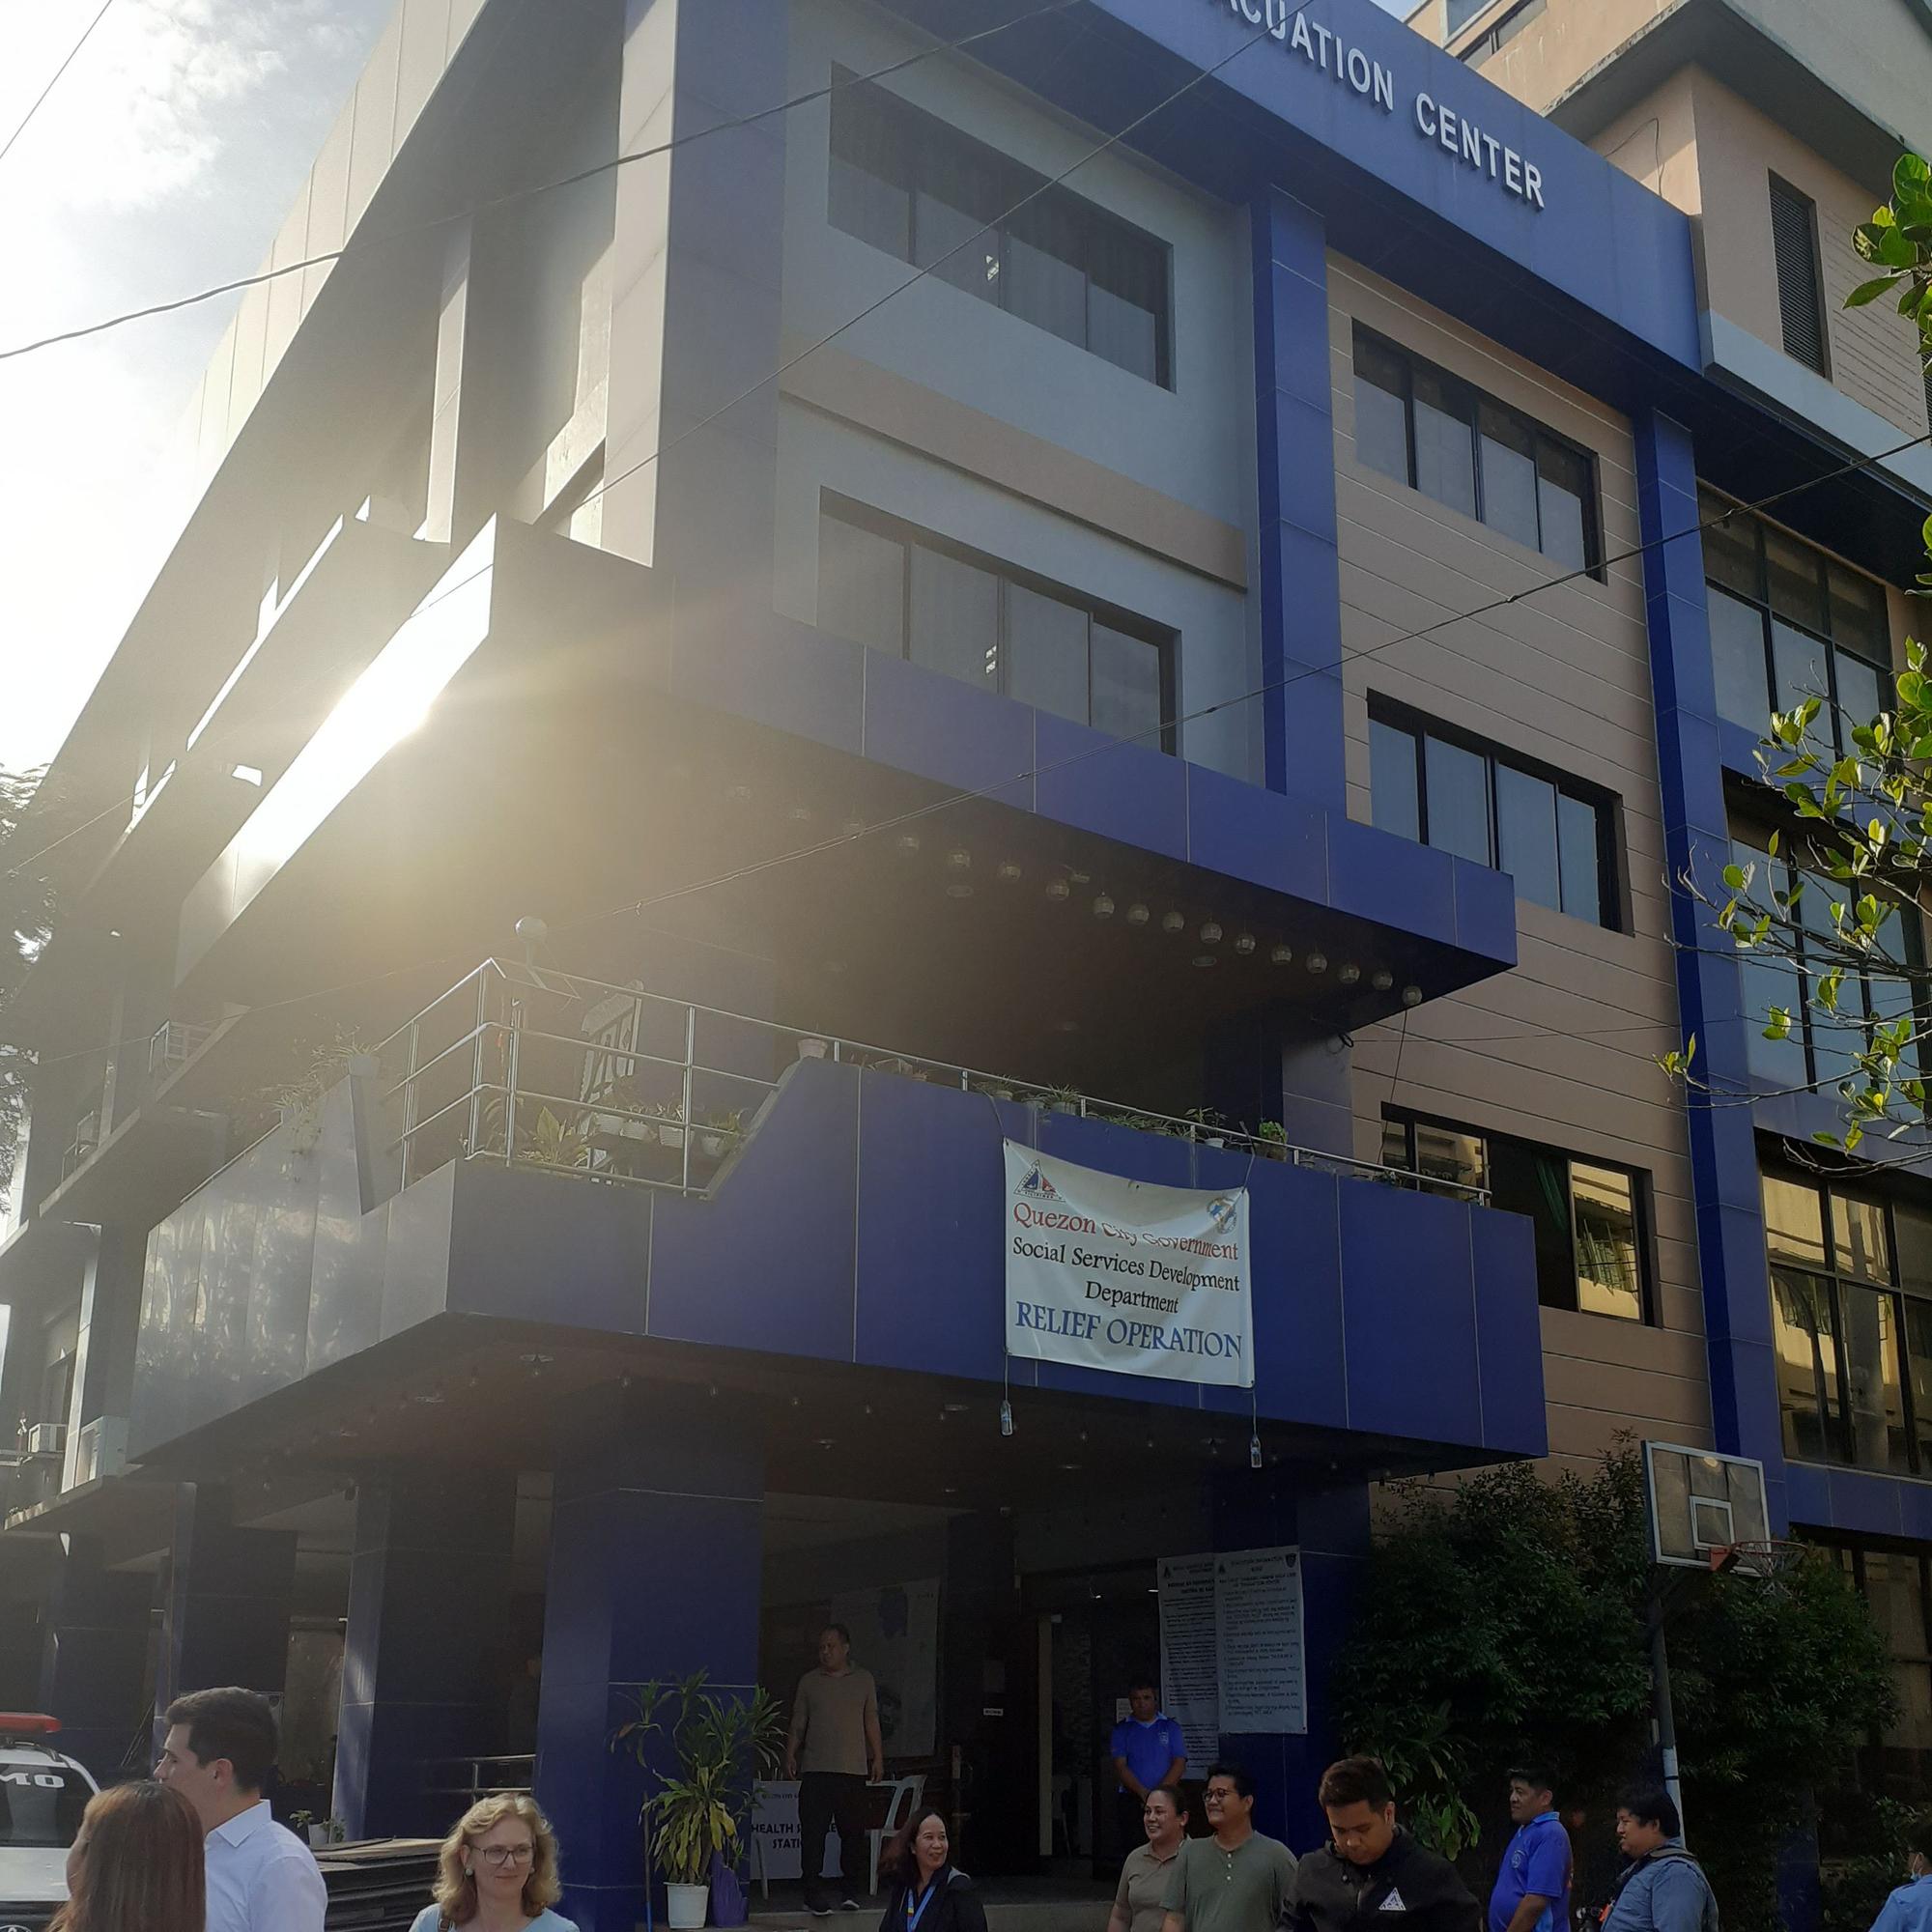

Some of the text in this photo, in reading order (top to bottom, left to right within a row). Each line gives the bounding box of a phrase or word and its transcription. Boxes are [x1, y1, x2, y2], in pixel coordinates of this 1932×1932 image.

[1229, 0, 1545, 209] CUATION CENTER
[1013, 1202, 1238, 1261] Quezon City Government
[1012, 1236, 1240, 1292] Social Services Development
[1084, 1280, 1179, 1314] Department
[1015, 1300, 1242, 1358] RELIEF OPERATION
[752, 1823, 794, 1833] HEALTH
[772, 1837, 802, 1849] STATI
